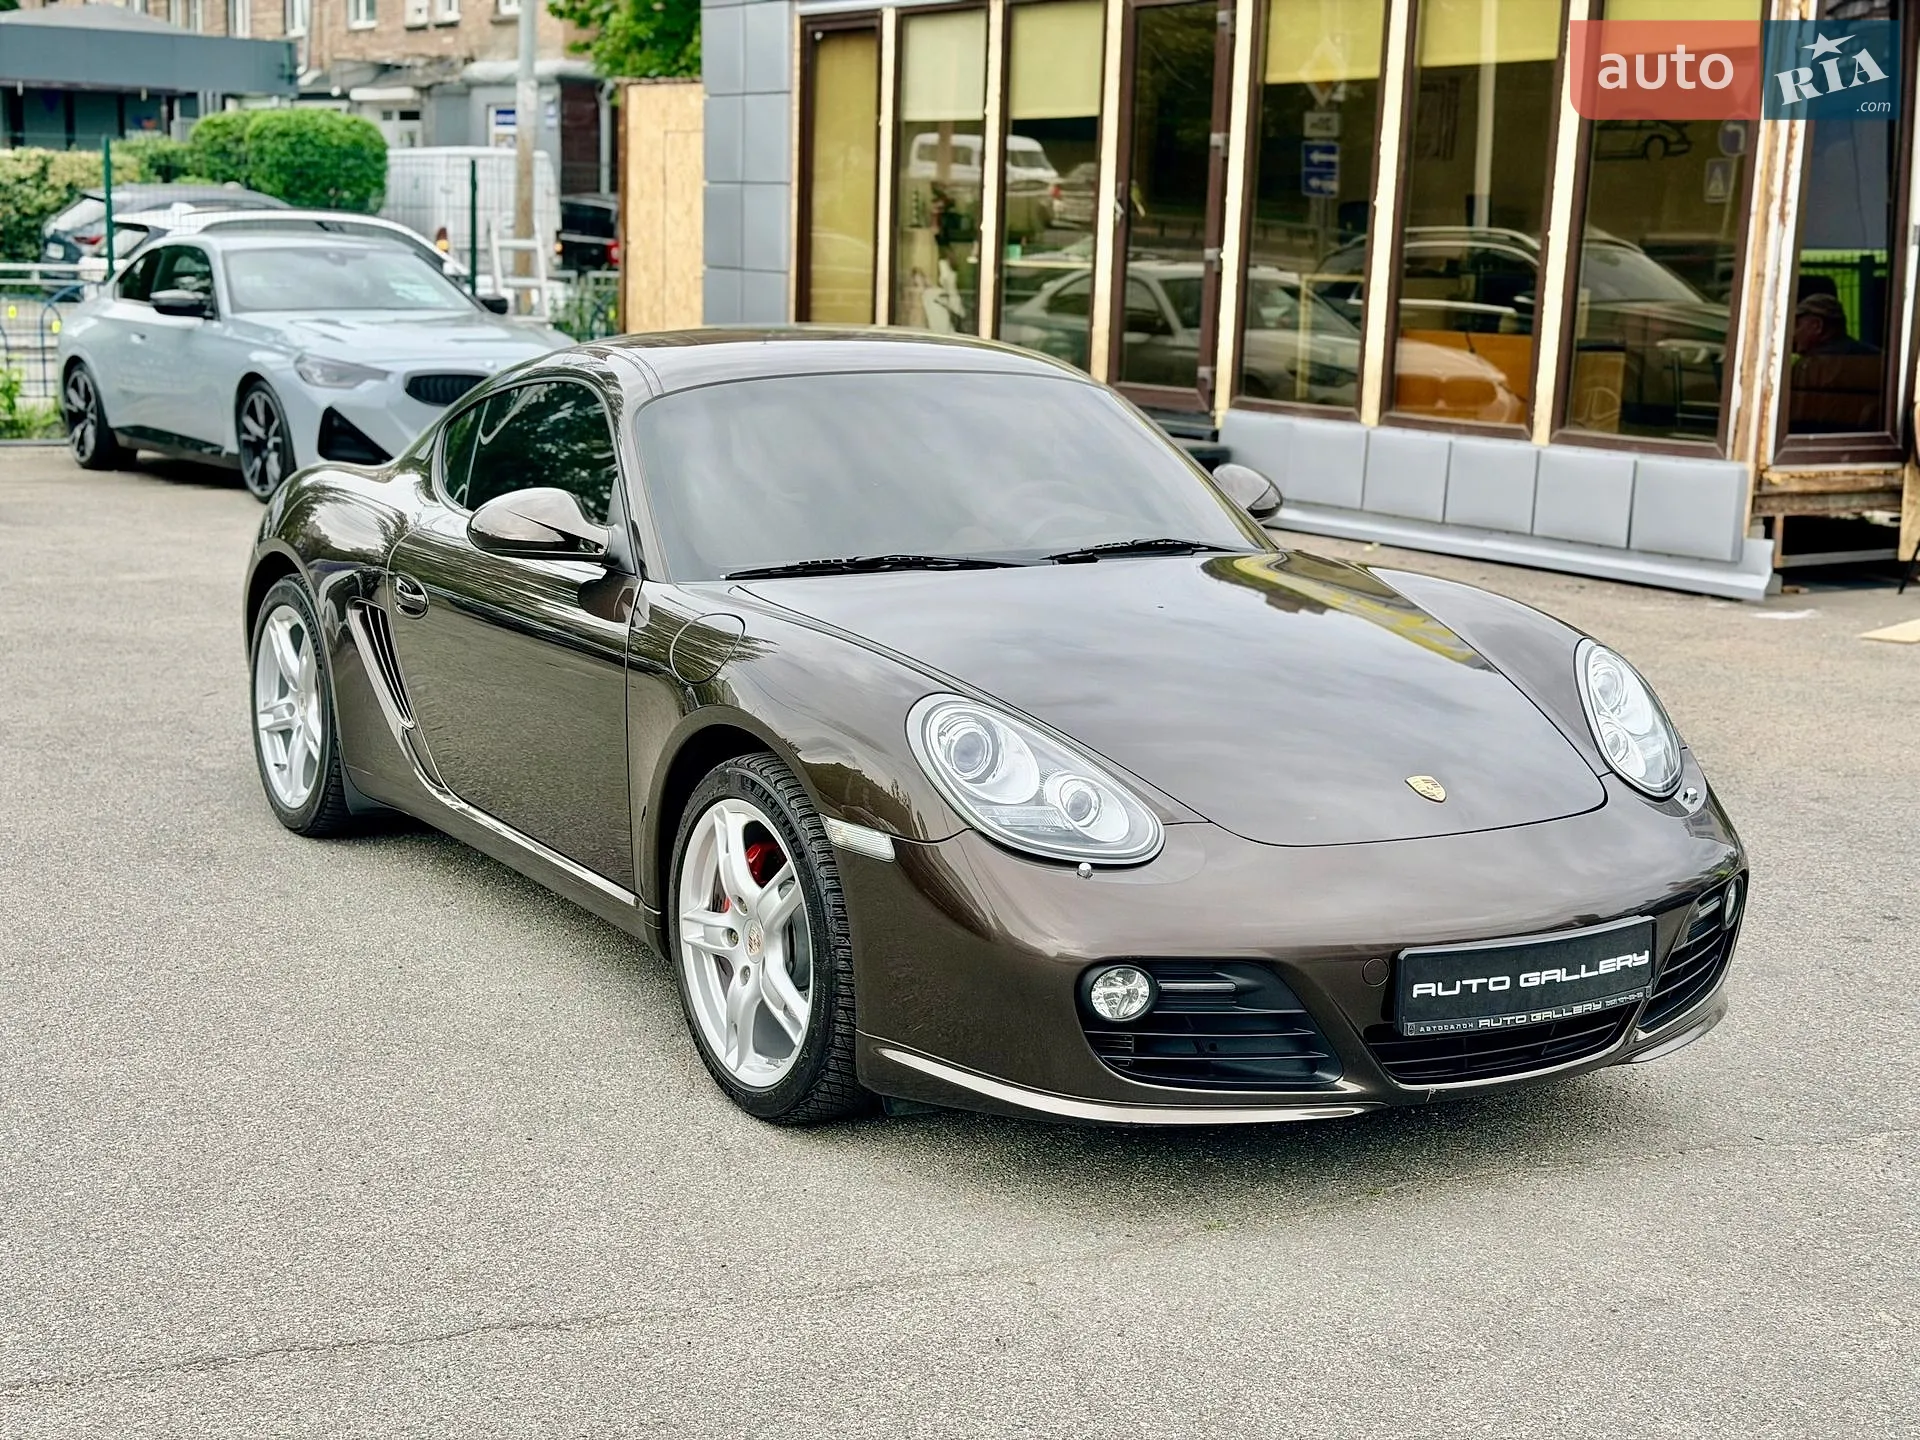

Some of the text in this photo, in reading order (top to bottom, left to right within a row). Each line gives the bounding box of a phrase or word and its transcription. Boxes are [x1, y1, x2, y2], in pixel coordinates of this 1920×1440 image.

[752, 782, 804, 854] MICHELIN
[1412, 950, 1650, 998] AUTO GALLERY
[1478, 1014, 1527, 1028] AUTO
[1530, 1001, 1602, 1022] GALLERY
